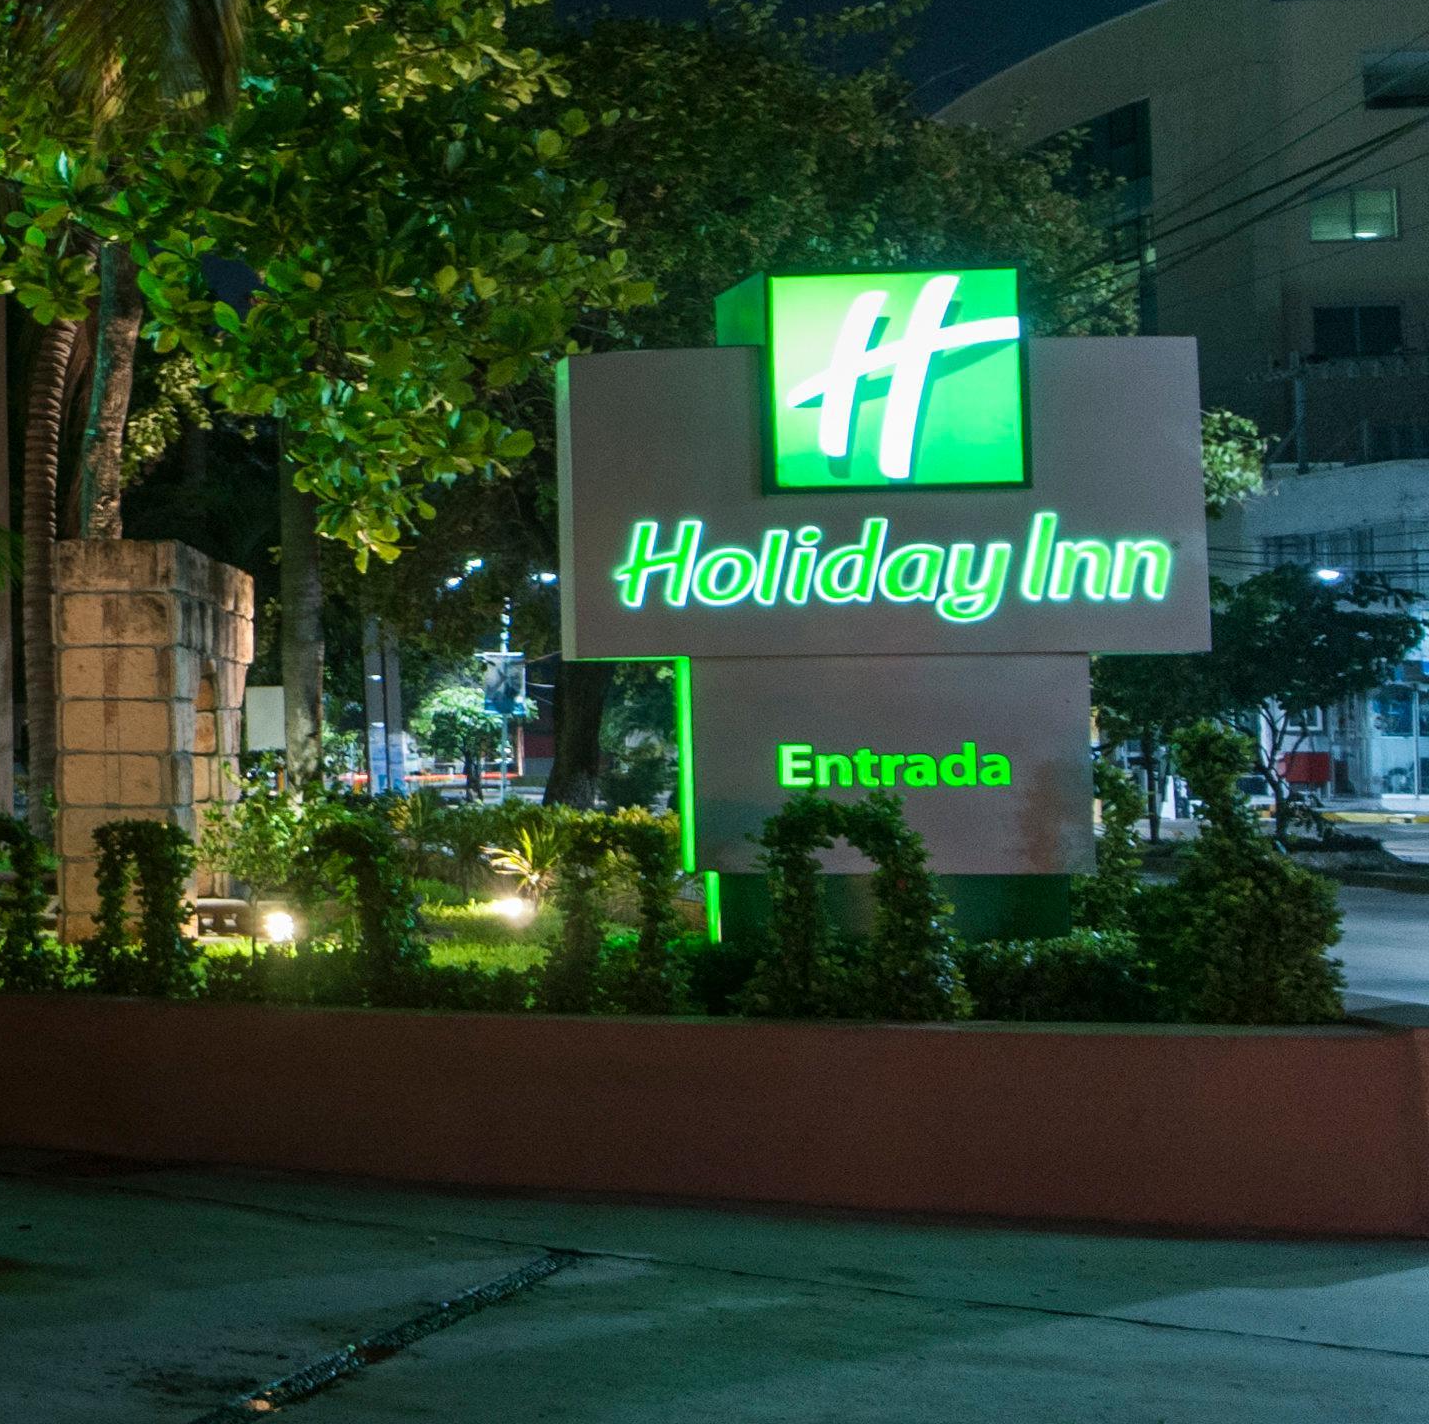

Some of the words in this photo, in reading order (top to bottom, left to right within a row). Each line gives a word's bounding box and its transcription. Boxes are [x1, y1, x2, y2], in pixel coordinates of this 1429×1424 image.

[786, 275, 1020, 480] H
[613, 516, 1013, 624] Holiday
[1020, 511, 1175, 603] Inn
[775, 742, 1012, 789] Entrada
